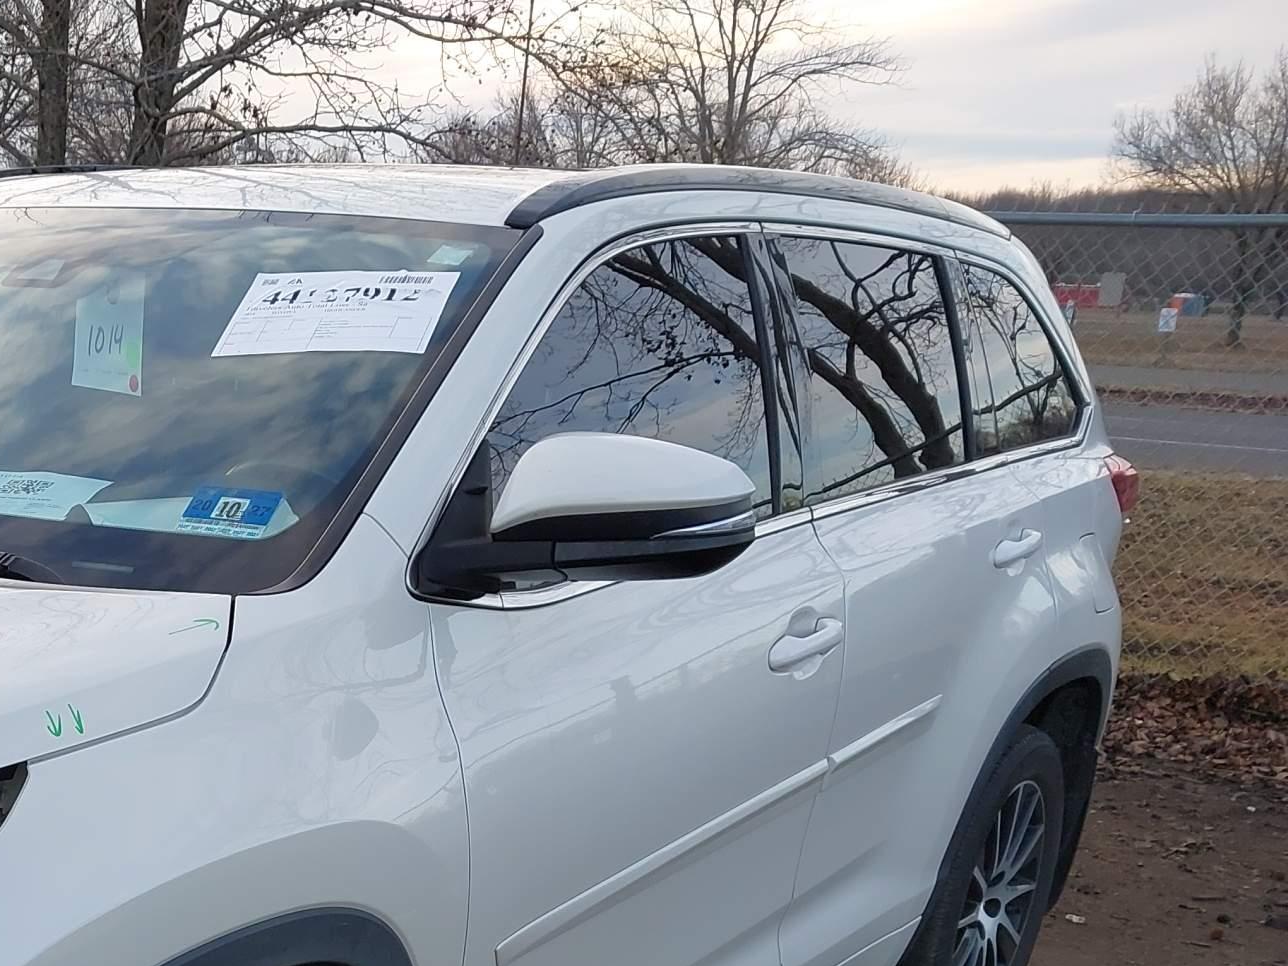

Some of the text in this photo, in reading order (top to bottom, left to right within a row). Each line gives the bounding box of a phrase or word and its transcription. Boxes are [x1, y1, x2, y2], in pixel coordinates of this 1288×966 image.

[88, 324, 124, 357] 1014
[192, 500, 273, 518] 20 10 27
